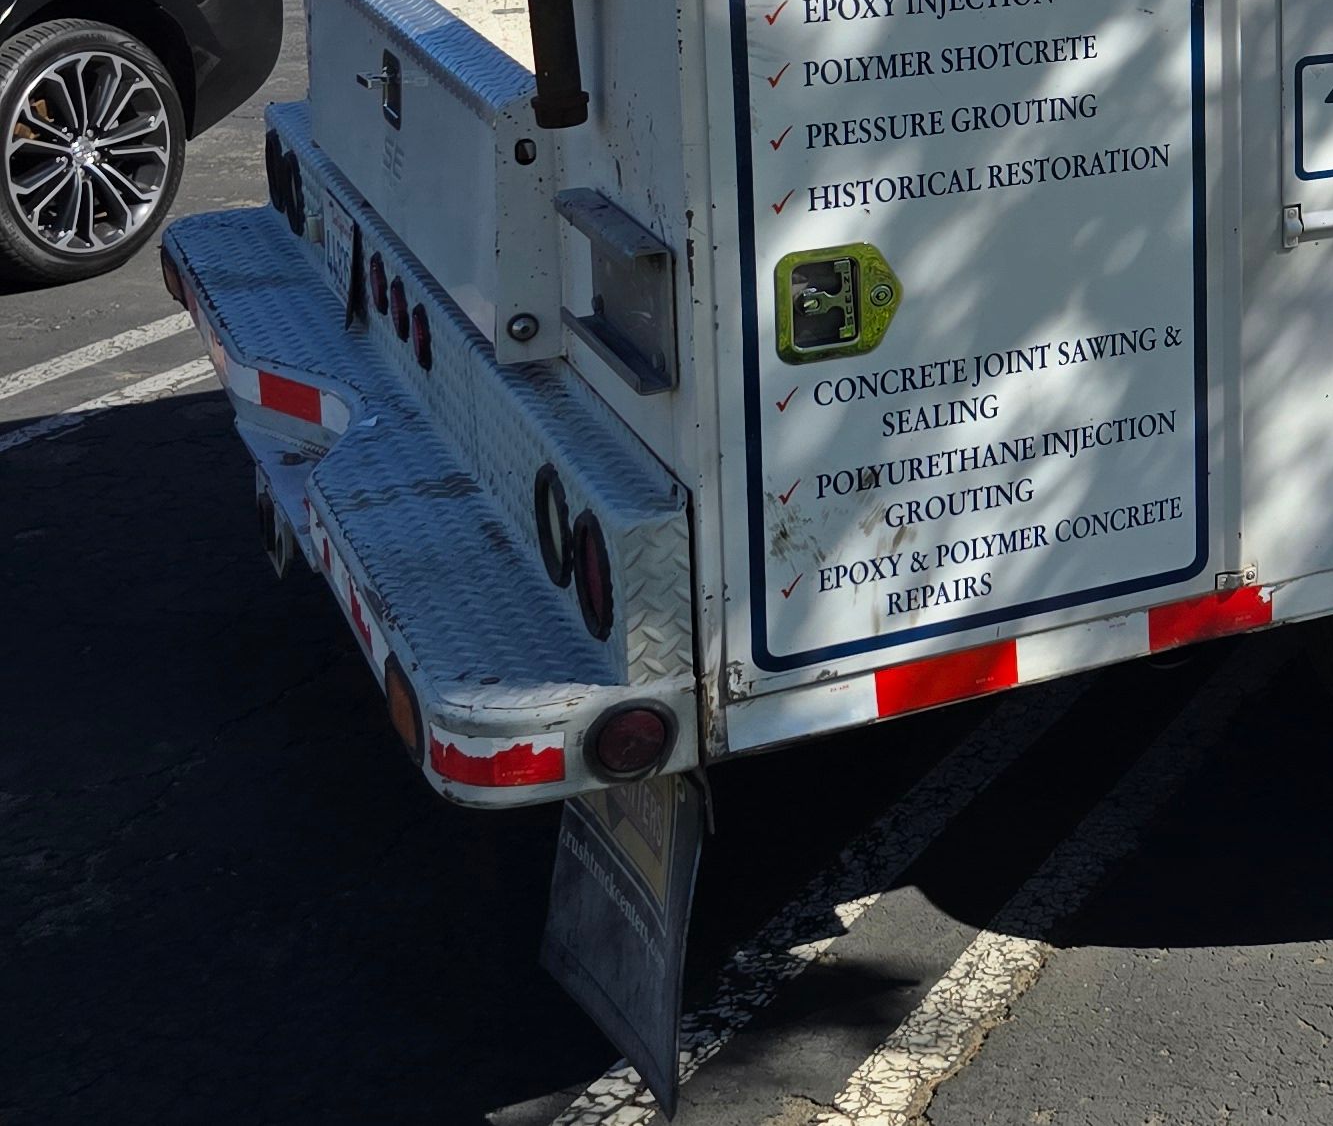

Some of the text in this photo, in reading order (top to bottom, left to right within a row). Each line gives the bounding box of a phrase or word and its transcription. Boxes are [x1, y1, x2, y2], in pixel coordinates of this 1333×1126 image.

[802, 34, 1099, 87] POLYMER SHOTCRETE
[805, 93, 1099, 150] PRESSURE GROUTING
[807, 142, 1172, 213] HISTORICAL RESTORATION
[813, 324, 1183, 407] CONCRETE JOINT SAWING &
[881, 394, 1000, 437] SEALING
[815, 410, 1177, 500] POLYURETHANE INJECTION
[884, 478, 1035, 529] GROUTING
[818, 495, 1184, 593] EPOXY & POLYMER CONCRETE
[886, 572, 993, 617] REPAIRS
